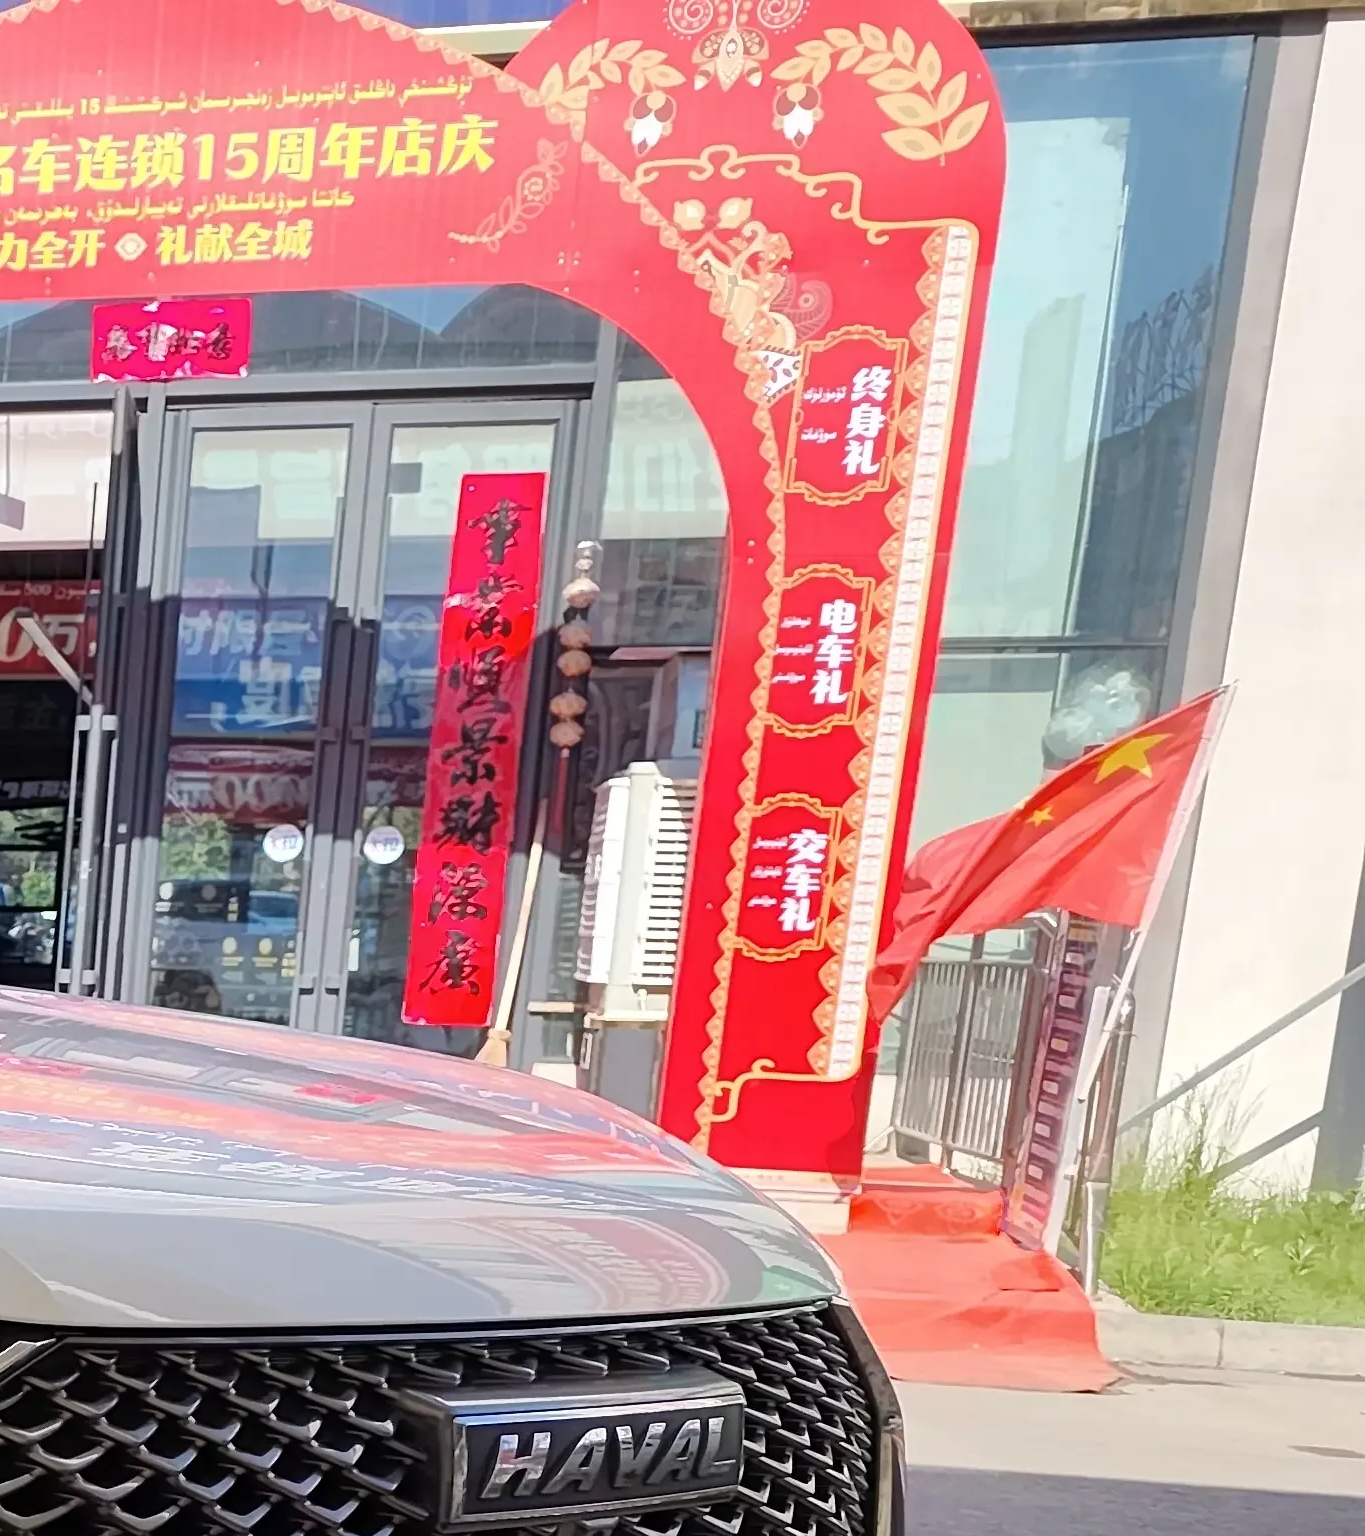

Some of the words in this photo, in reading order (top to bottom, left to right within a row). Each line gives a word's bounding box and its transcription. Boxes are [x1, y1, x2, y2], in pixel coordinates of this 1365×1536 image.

[80, 96, 101, 116] 15
[156, 218, 314, 266] 礼献全城
[841, 365, 892, 476] 终身礼
[24, 582, 51, 597] 500
[809, 599, 857, 704] 电车礼
[778, 828, 829, 932] 交车礼
[480, 1416, 737, 1499] HAVAL
